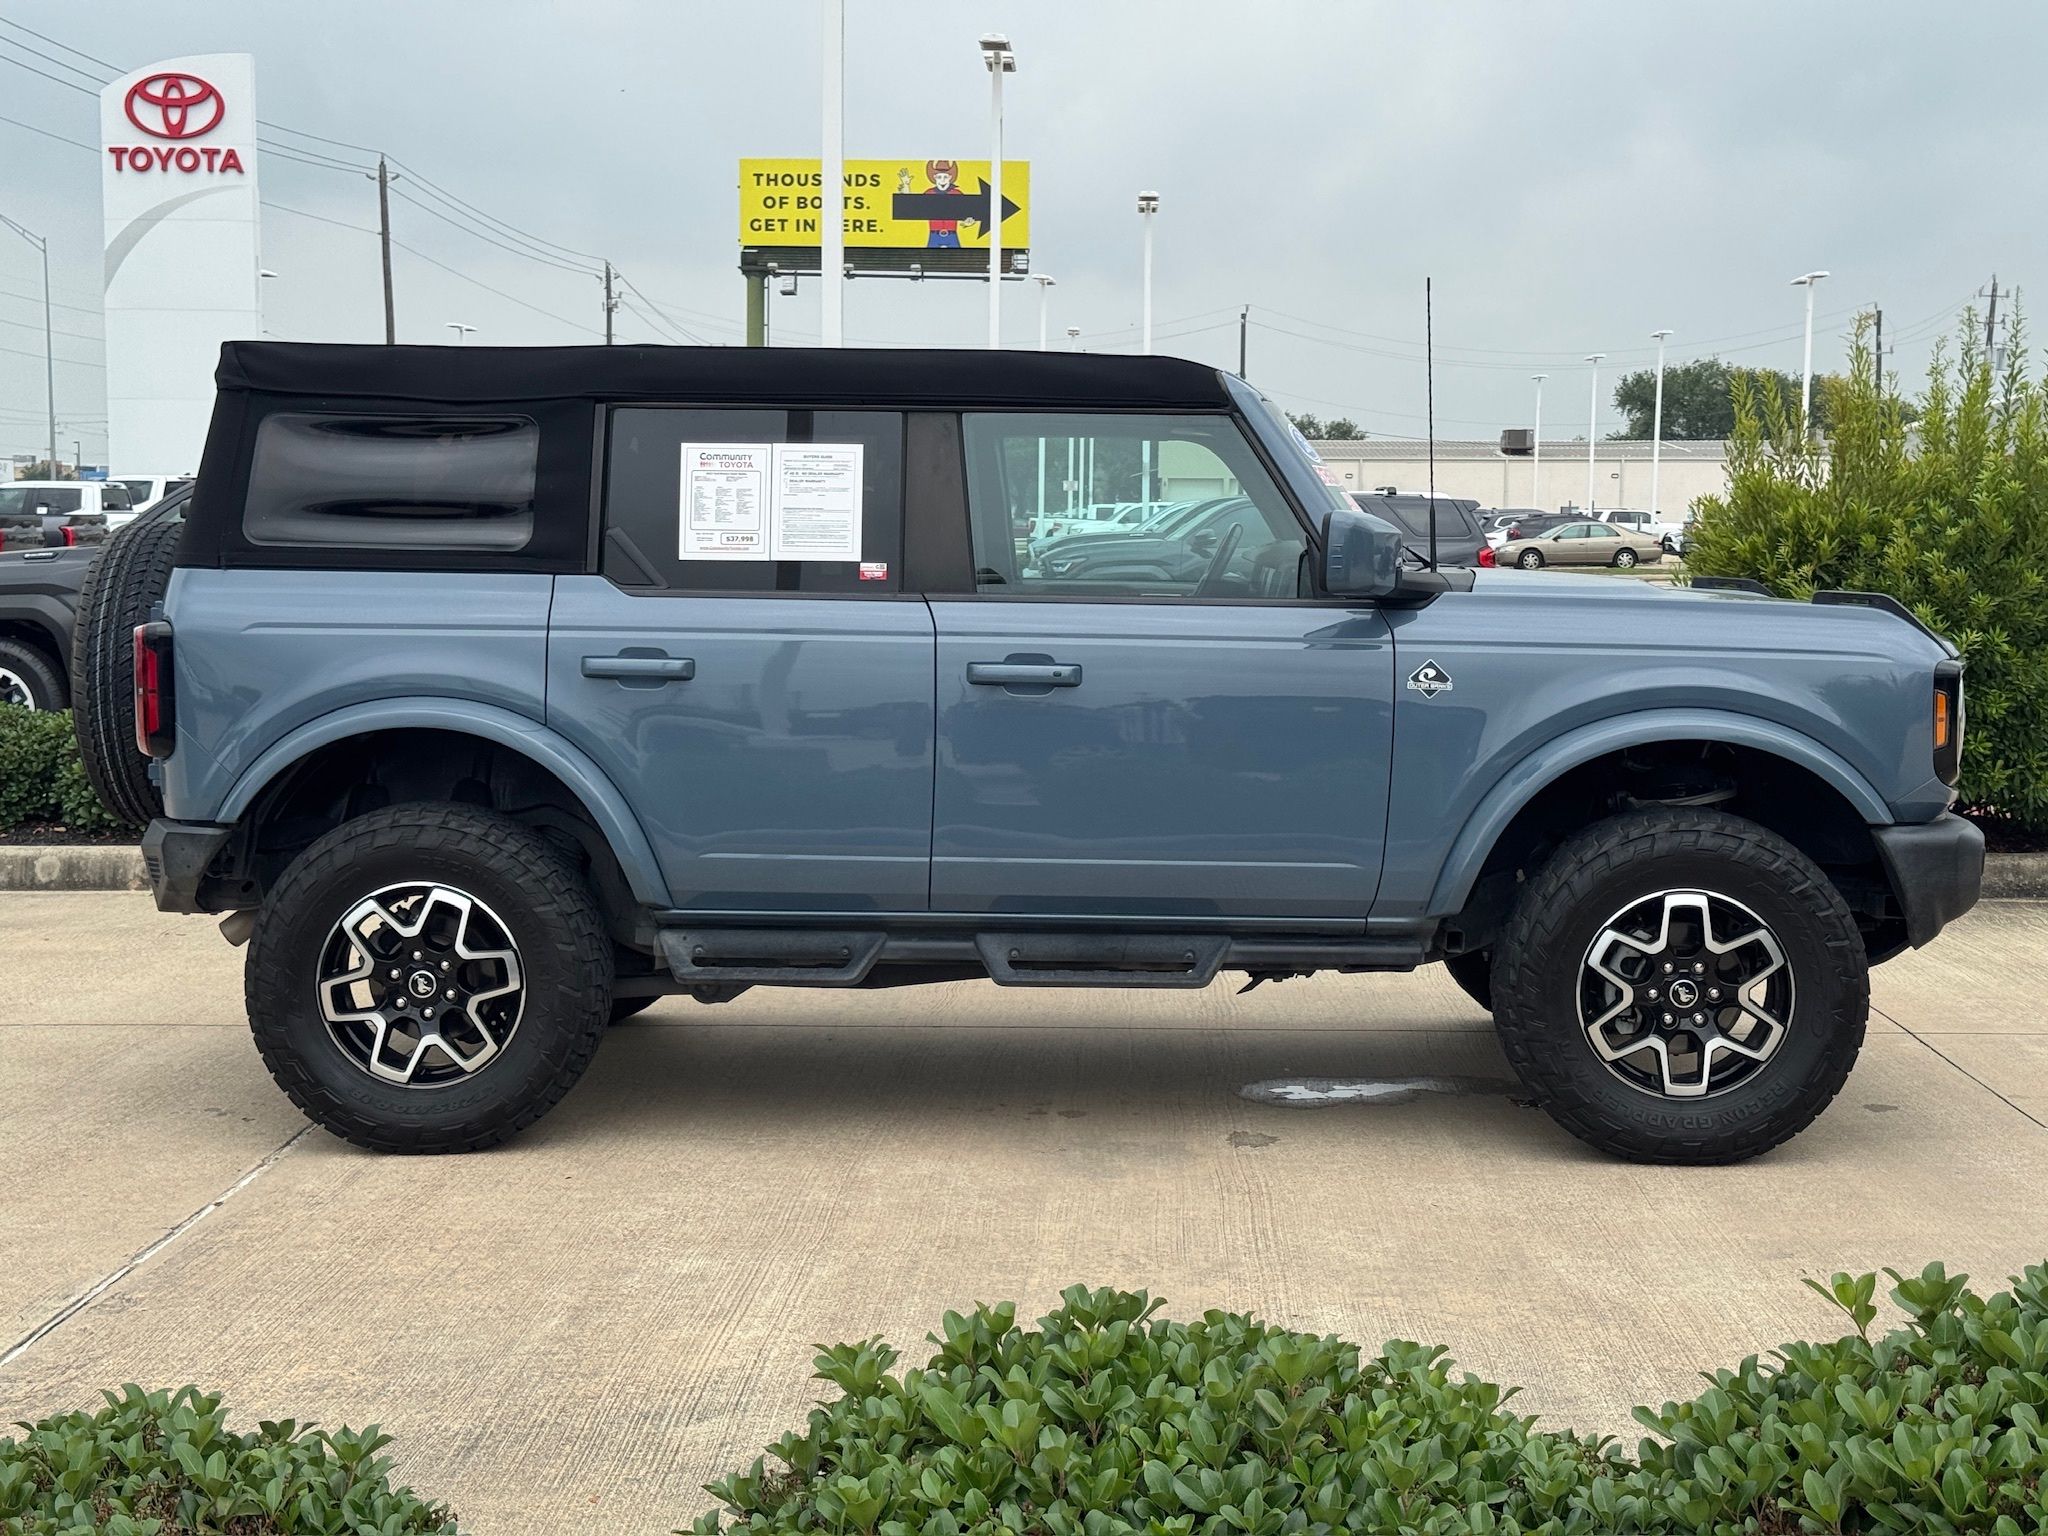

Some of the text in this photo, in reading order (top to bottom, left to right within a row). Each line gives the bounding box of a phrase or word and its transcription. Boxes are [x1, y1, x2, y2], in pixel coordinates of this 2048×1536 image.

[108, 146, 244, 173] TOYOTA
[753, 173, 881, 187] THOUSNDS
[763, 196, 870, 210] OF BOTS.
[750, 218, 884, 233] GET IN ERE.
